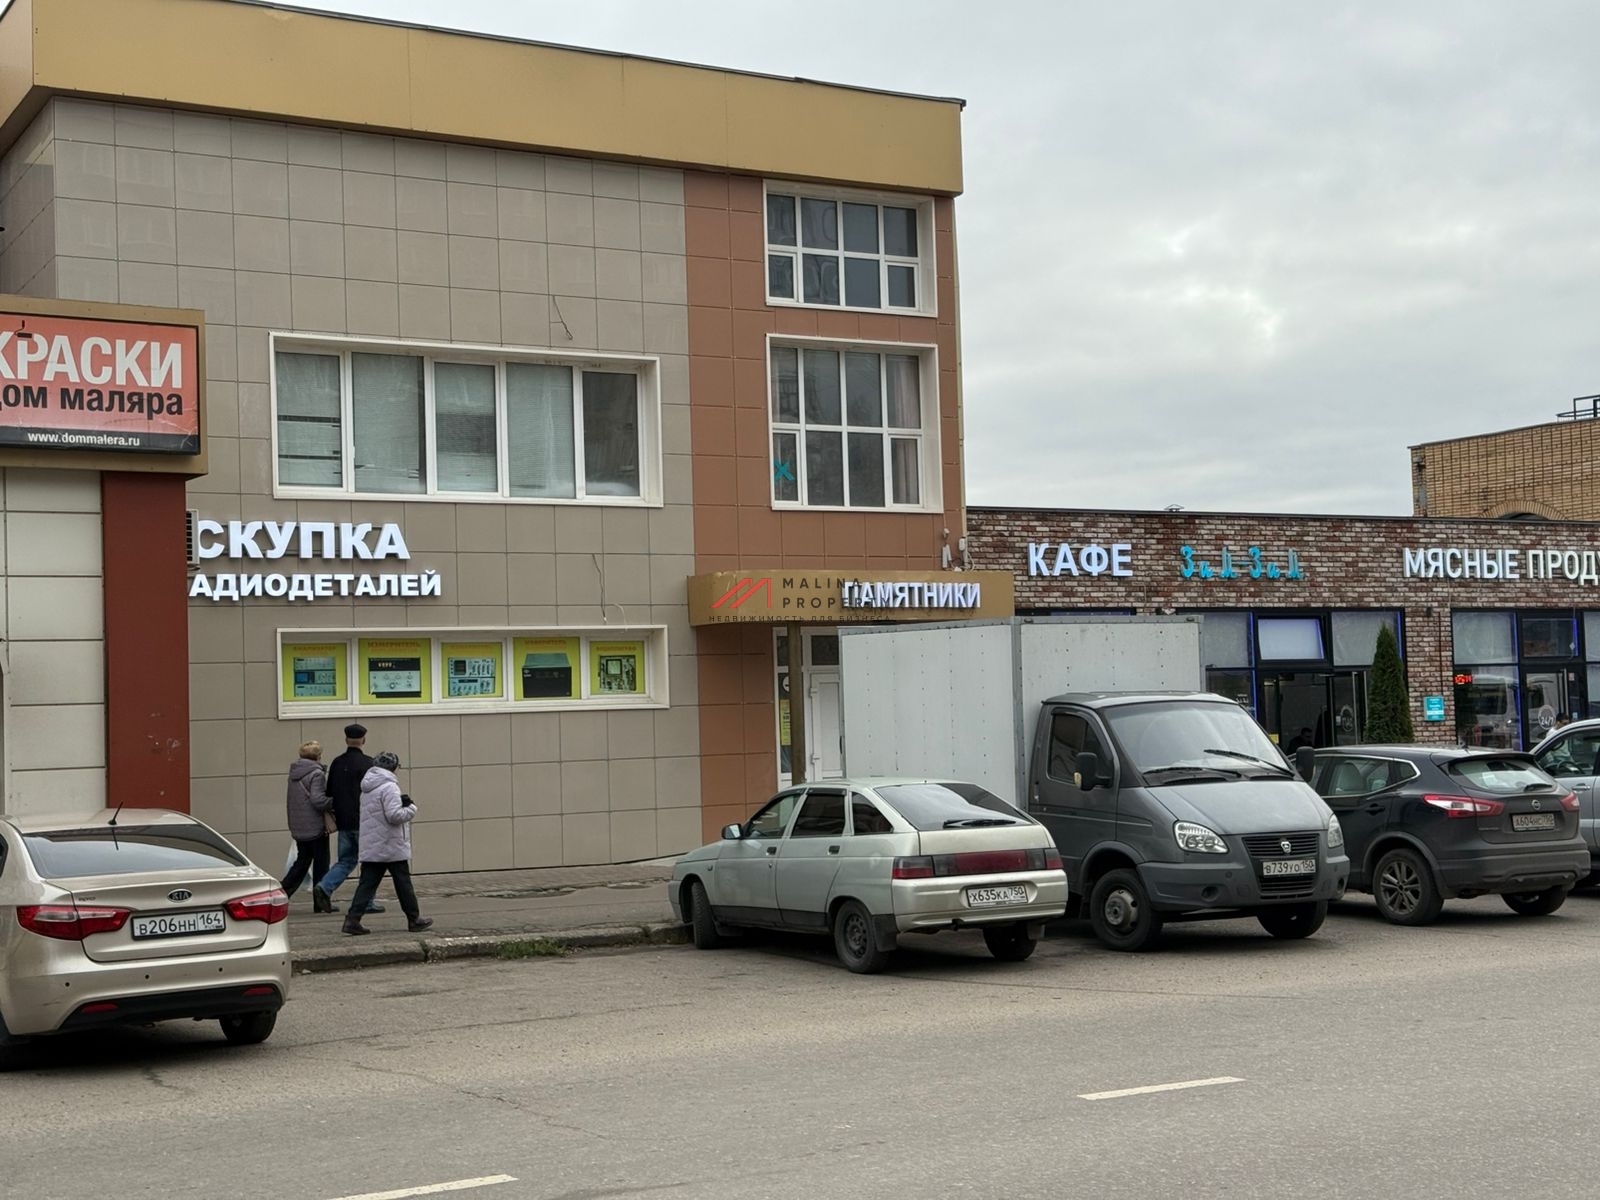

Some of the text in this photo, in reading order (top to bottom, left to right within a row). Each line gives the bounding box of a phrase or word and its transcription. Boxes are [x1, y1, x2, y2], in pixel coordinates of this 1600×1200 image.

[0, 384, 183, 420] ом маляра
[28, 432, 140, 446] www.dommalera.ru
[198, 520, 411, 559] СКУПКА
[1028, 542, 1133, 577] КАФЕ
[1403, 547, 1600, 586] МЯСНЫЕ ПРОД
[842, 581, 981, 608] ПАМЯТНИКИ
[172, 890, 190, 900] KIA
